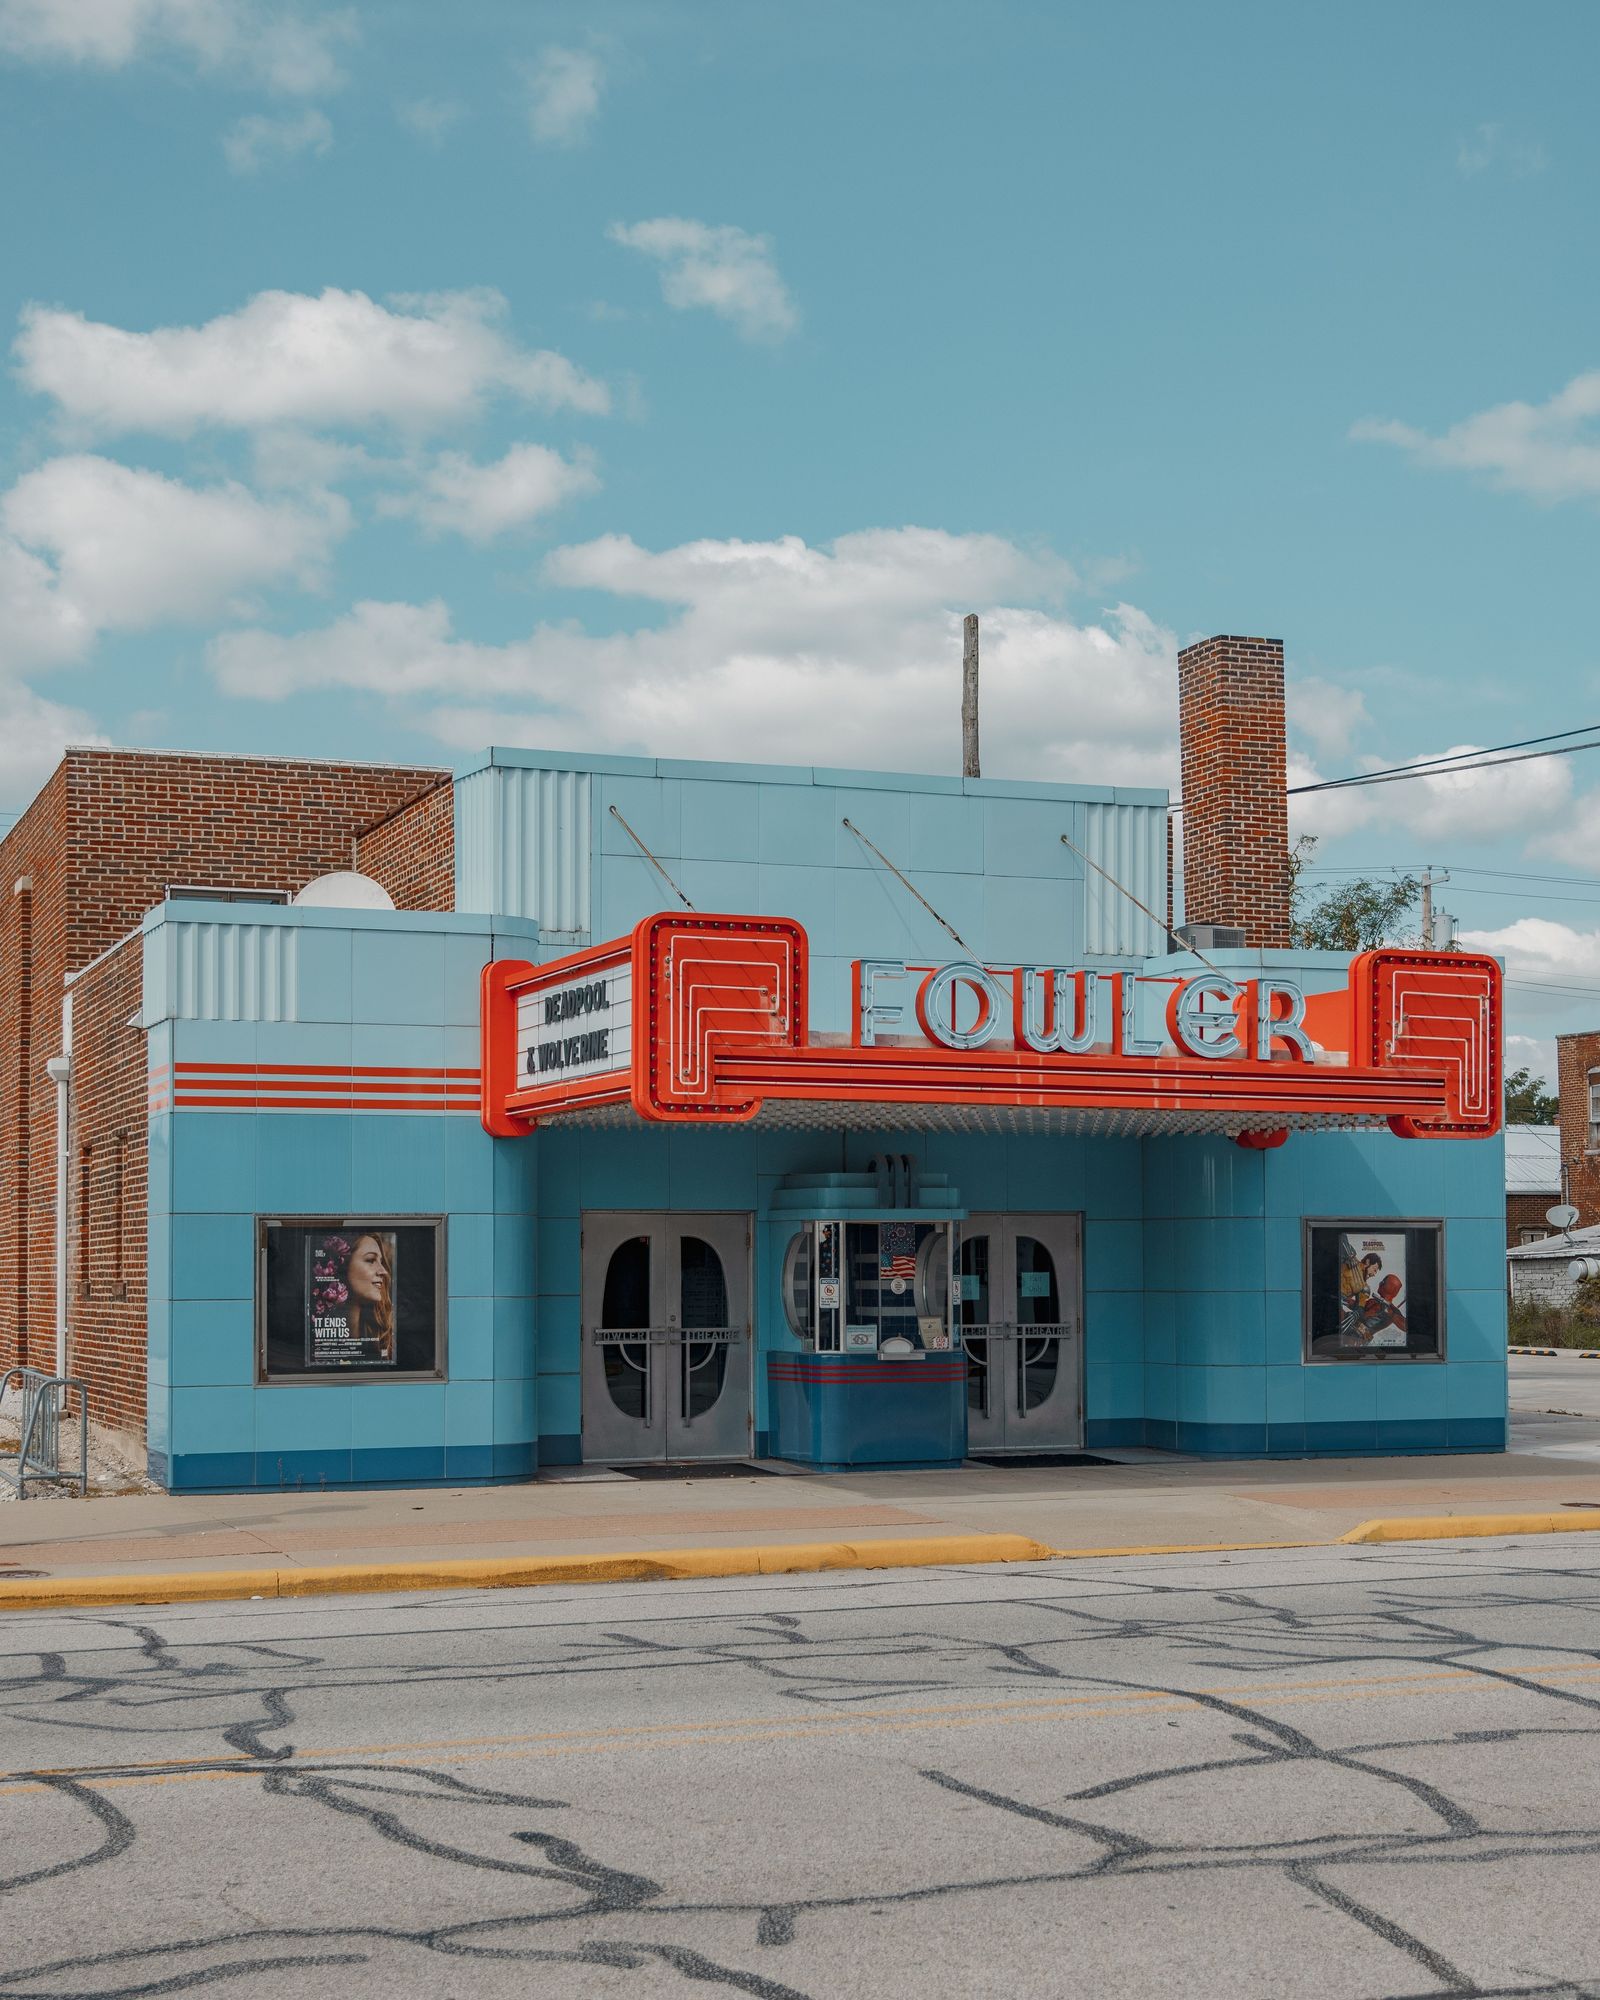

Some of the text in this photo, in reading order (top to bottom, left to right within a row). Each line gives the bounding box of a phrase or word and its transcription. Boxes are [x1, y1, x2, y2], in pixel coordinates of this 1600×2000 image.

[544, 979, 610, 1025] DEADPOOL
[852, 959, 1315, 1063] FOWLER
[526, 1027, 609, 1075] & WOLVERINE
[314, 1317, 347, 1328] IT ENDS
[314, 1327, 350, 1338] WITH US
